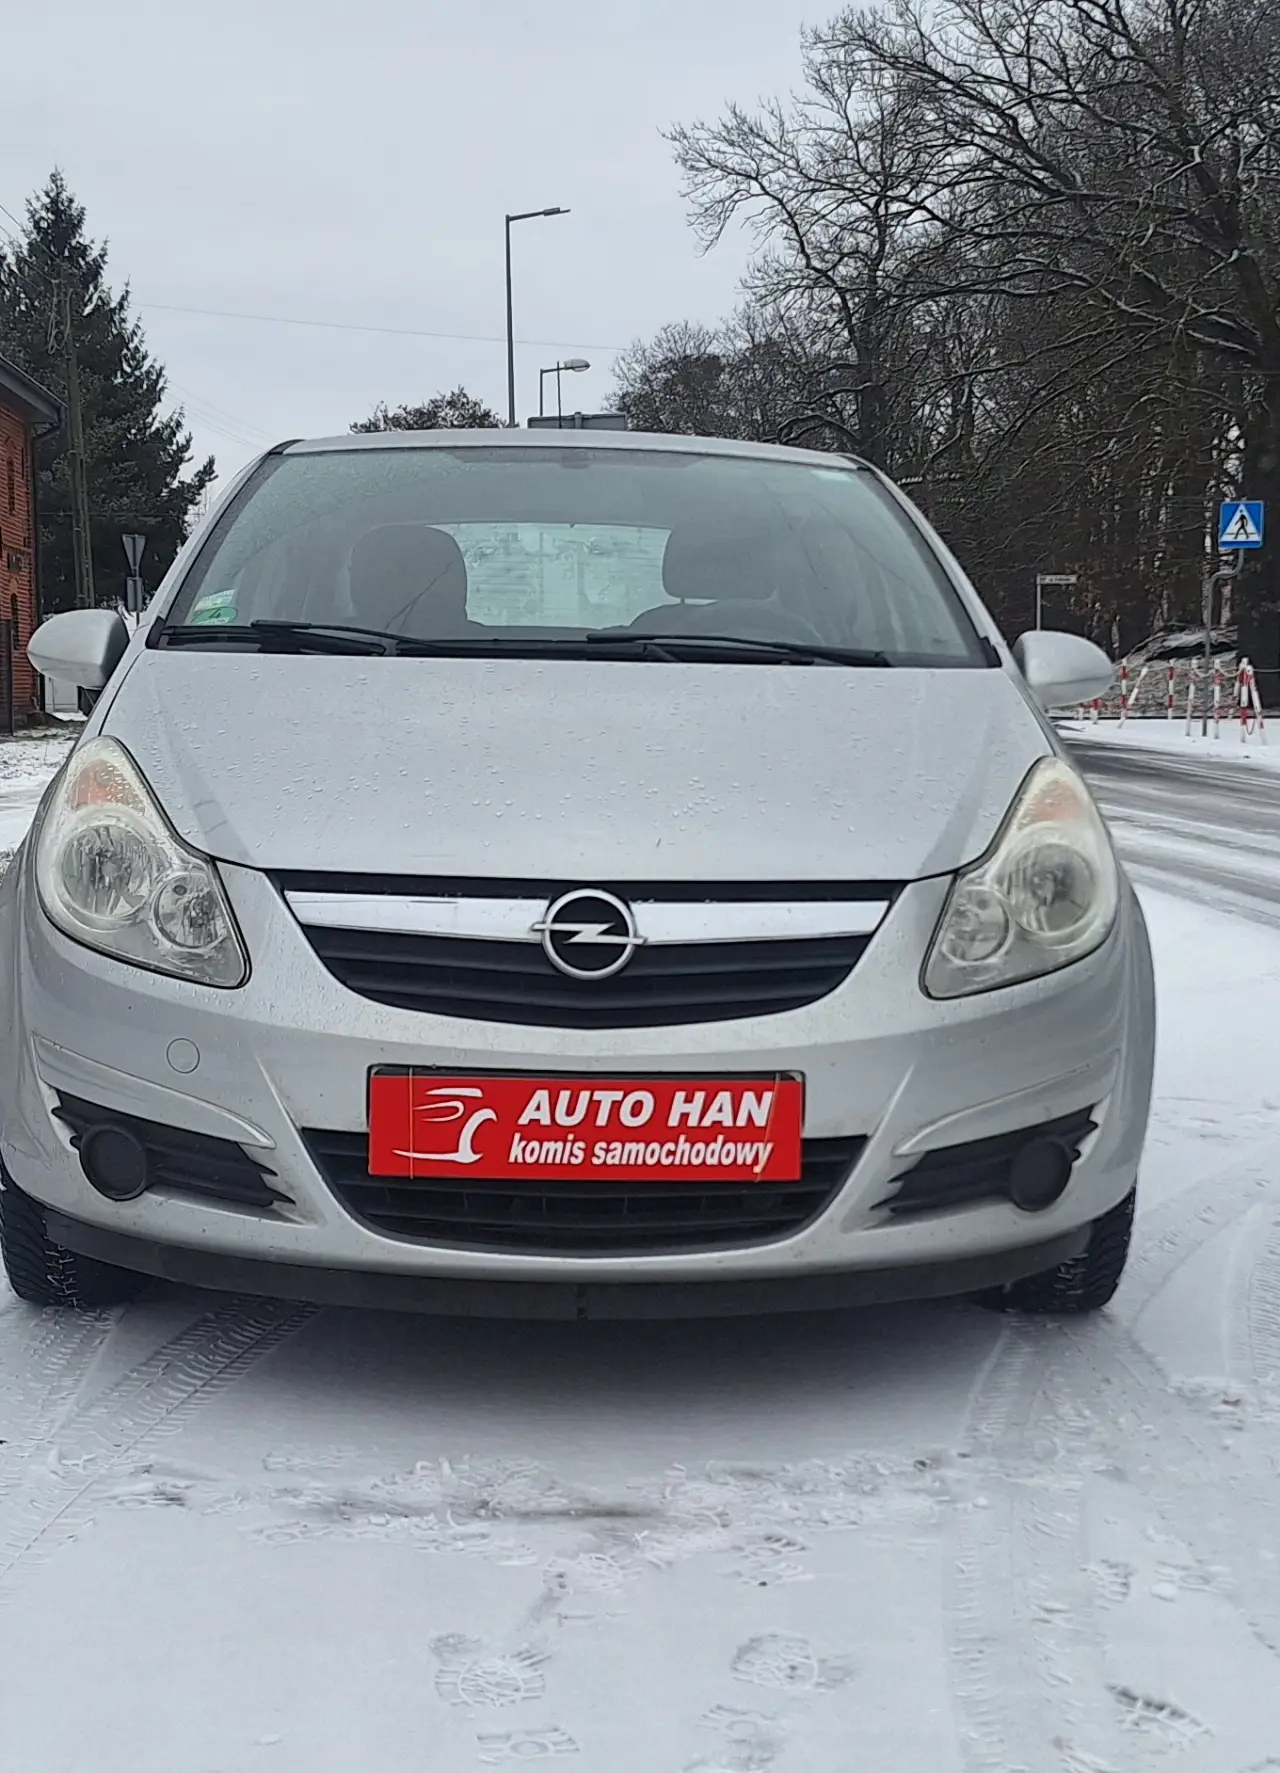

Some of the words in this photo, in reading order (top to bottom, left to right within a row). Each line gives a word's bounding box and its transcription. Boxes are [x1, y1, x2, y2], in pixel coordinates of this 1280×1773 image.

[517, 1089, 654, 1126] AUTO
[667, 1091, 776, 1128] HAN
[508, 1133, 586, 1166] komis
[591, 1135, 774, 1173] samochodowy
